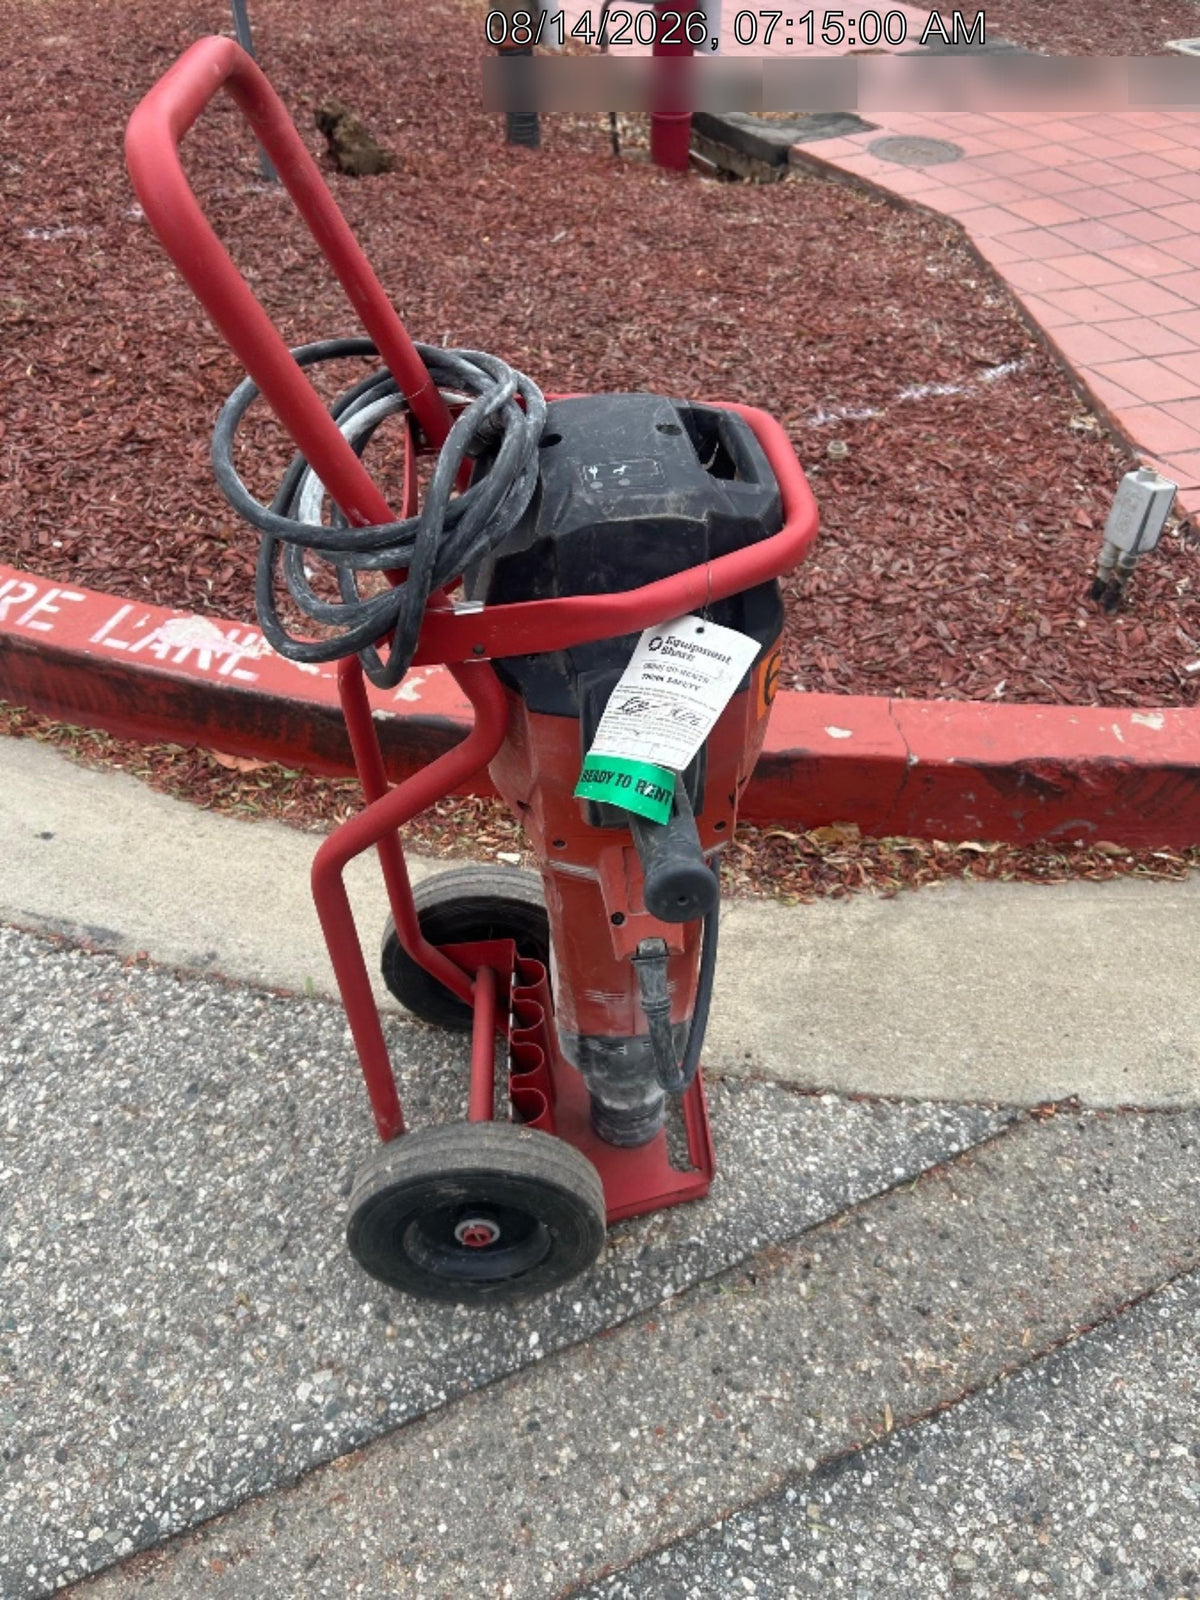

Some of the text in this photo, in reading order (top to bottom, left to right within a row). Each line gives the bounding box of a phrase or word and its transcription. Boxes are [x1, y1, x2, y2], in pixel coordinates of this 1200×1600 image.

[0, 577, 87, 631] RE
[665, 636, 732, 665] Equipment
[581, 769, 673, 805] READY TO RENT
